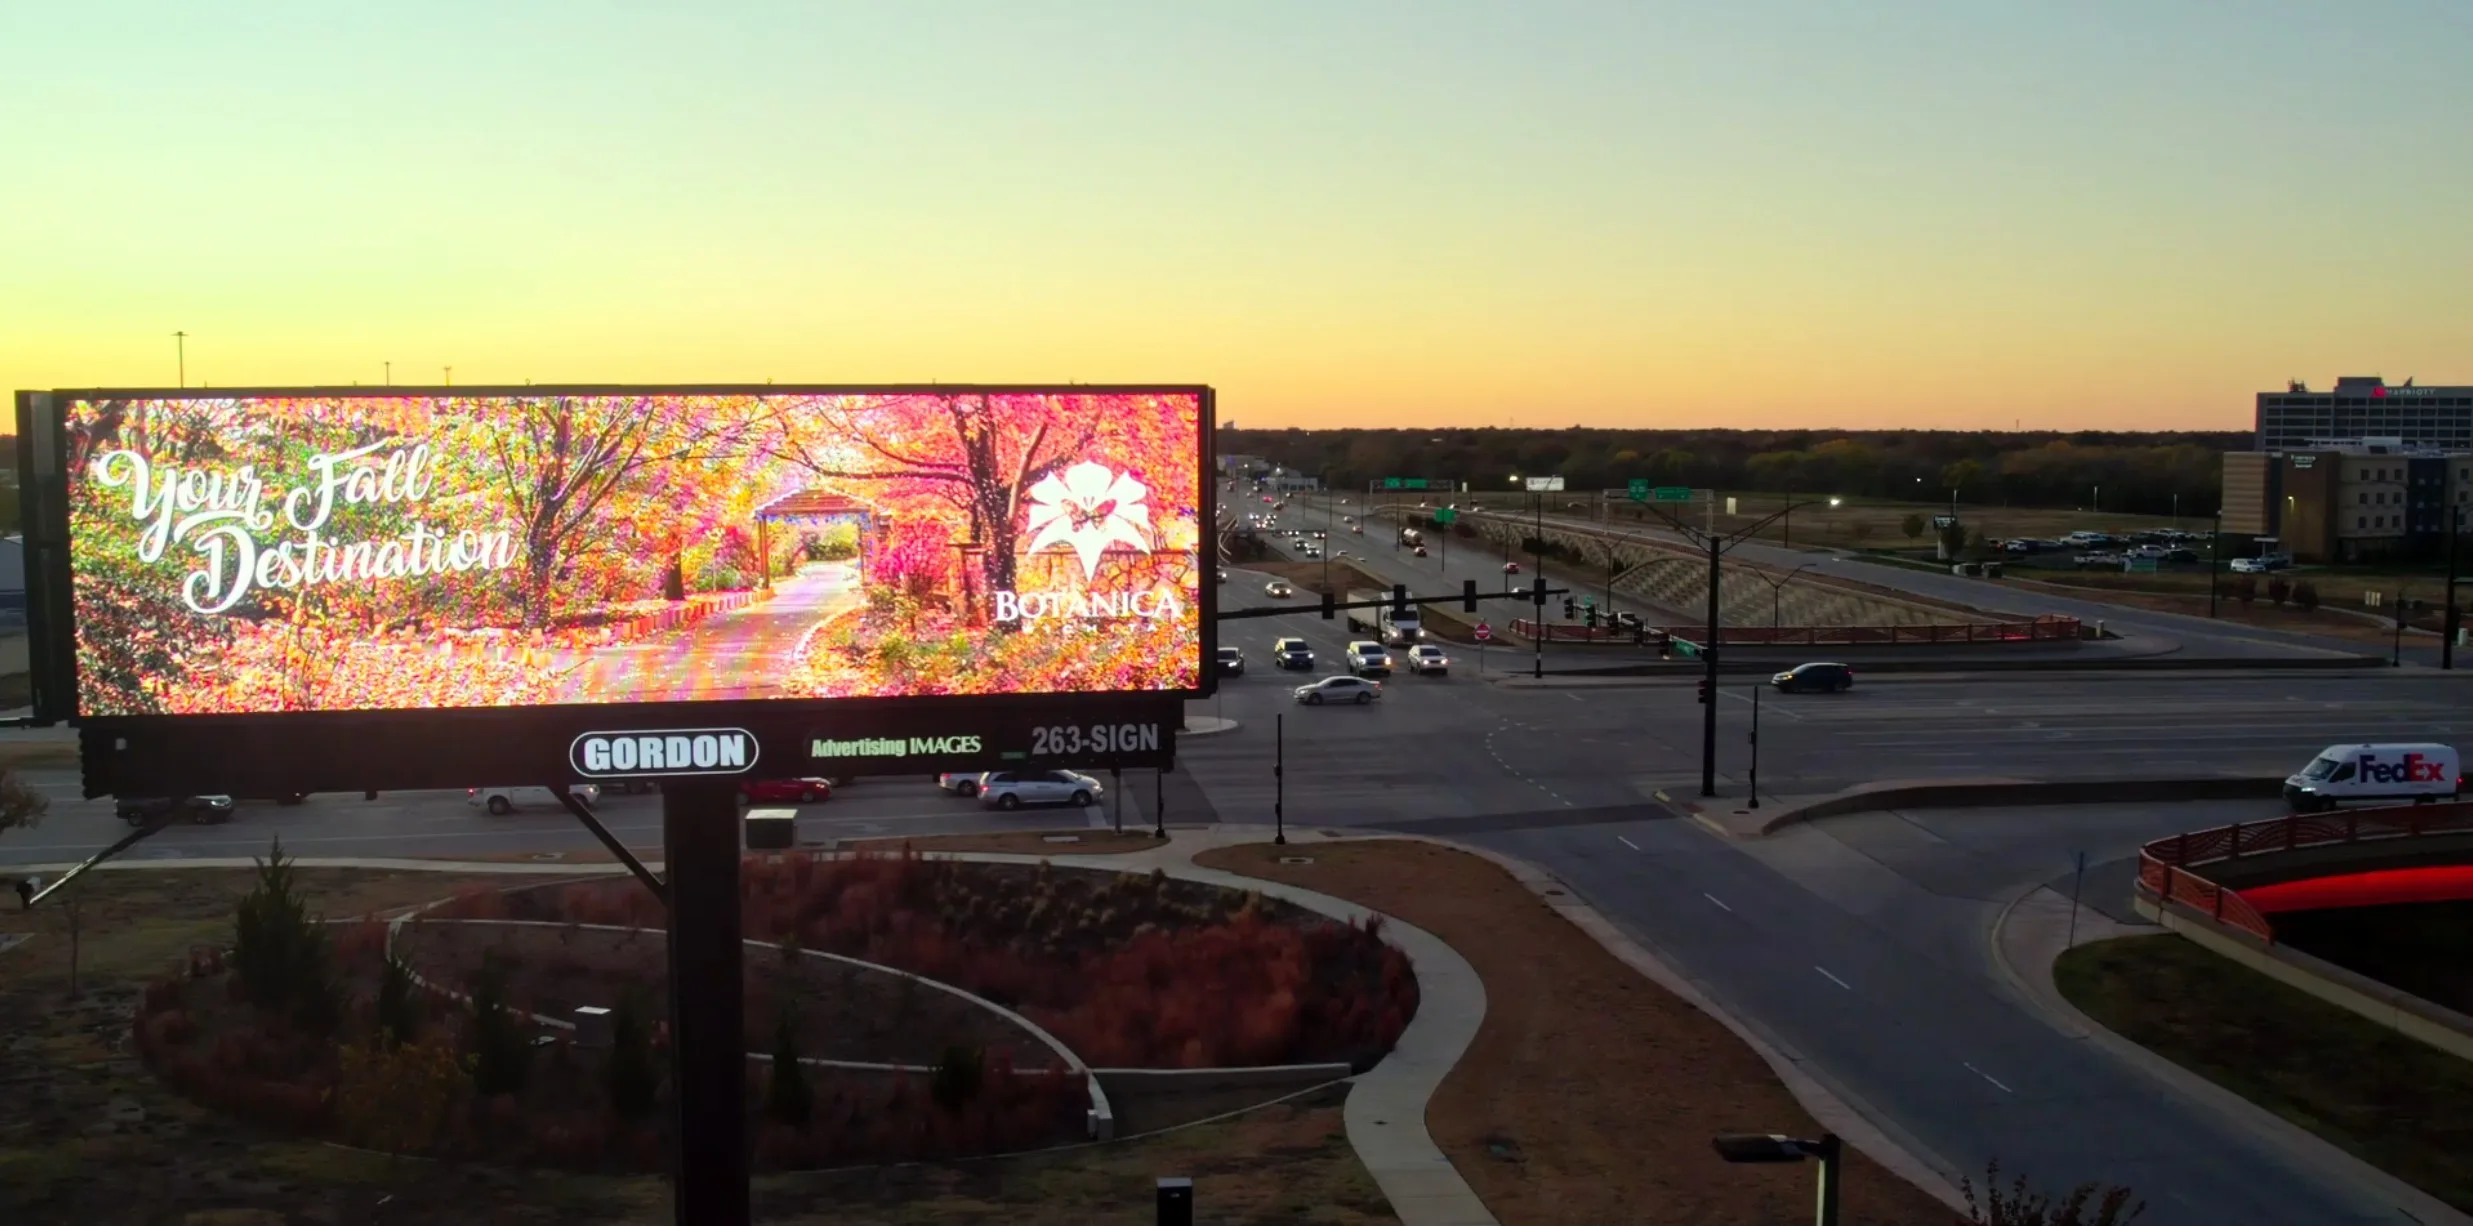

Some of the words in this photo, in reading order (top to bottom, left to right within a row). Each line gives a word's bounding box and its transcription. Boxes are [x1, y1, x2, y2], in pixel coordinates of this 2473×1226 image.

[98, 449, 273, 563] Your
[286, 437, 433, 530] Fall
[183, 520, 519, 614] Destination
[995, 590, 1183, 621] BOTANICA
[584, 735, 745, 771] GORDON
[812, 738, 907, 757] Advertising
[910, 733, 983, 755] IMAGES
[1032, 723, 1159, 755] 263-SIGN
[2359, 753, 2445, 783] FedEx
